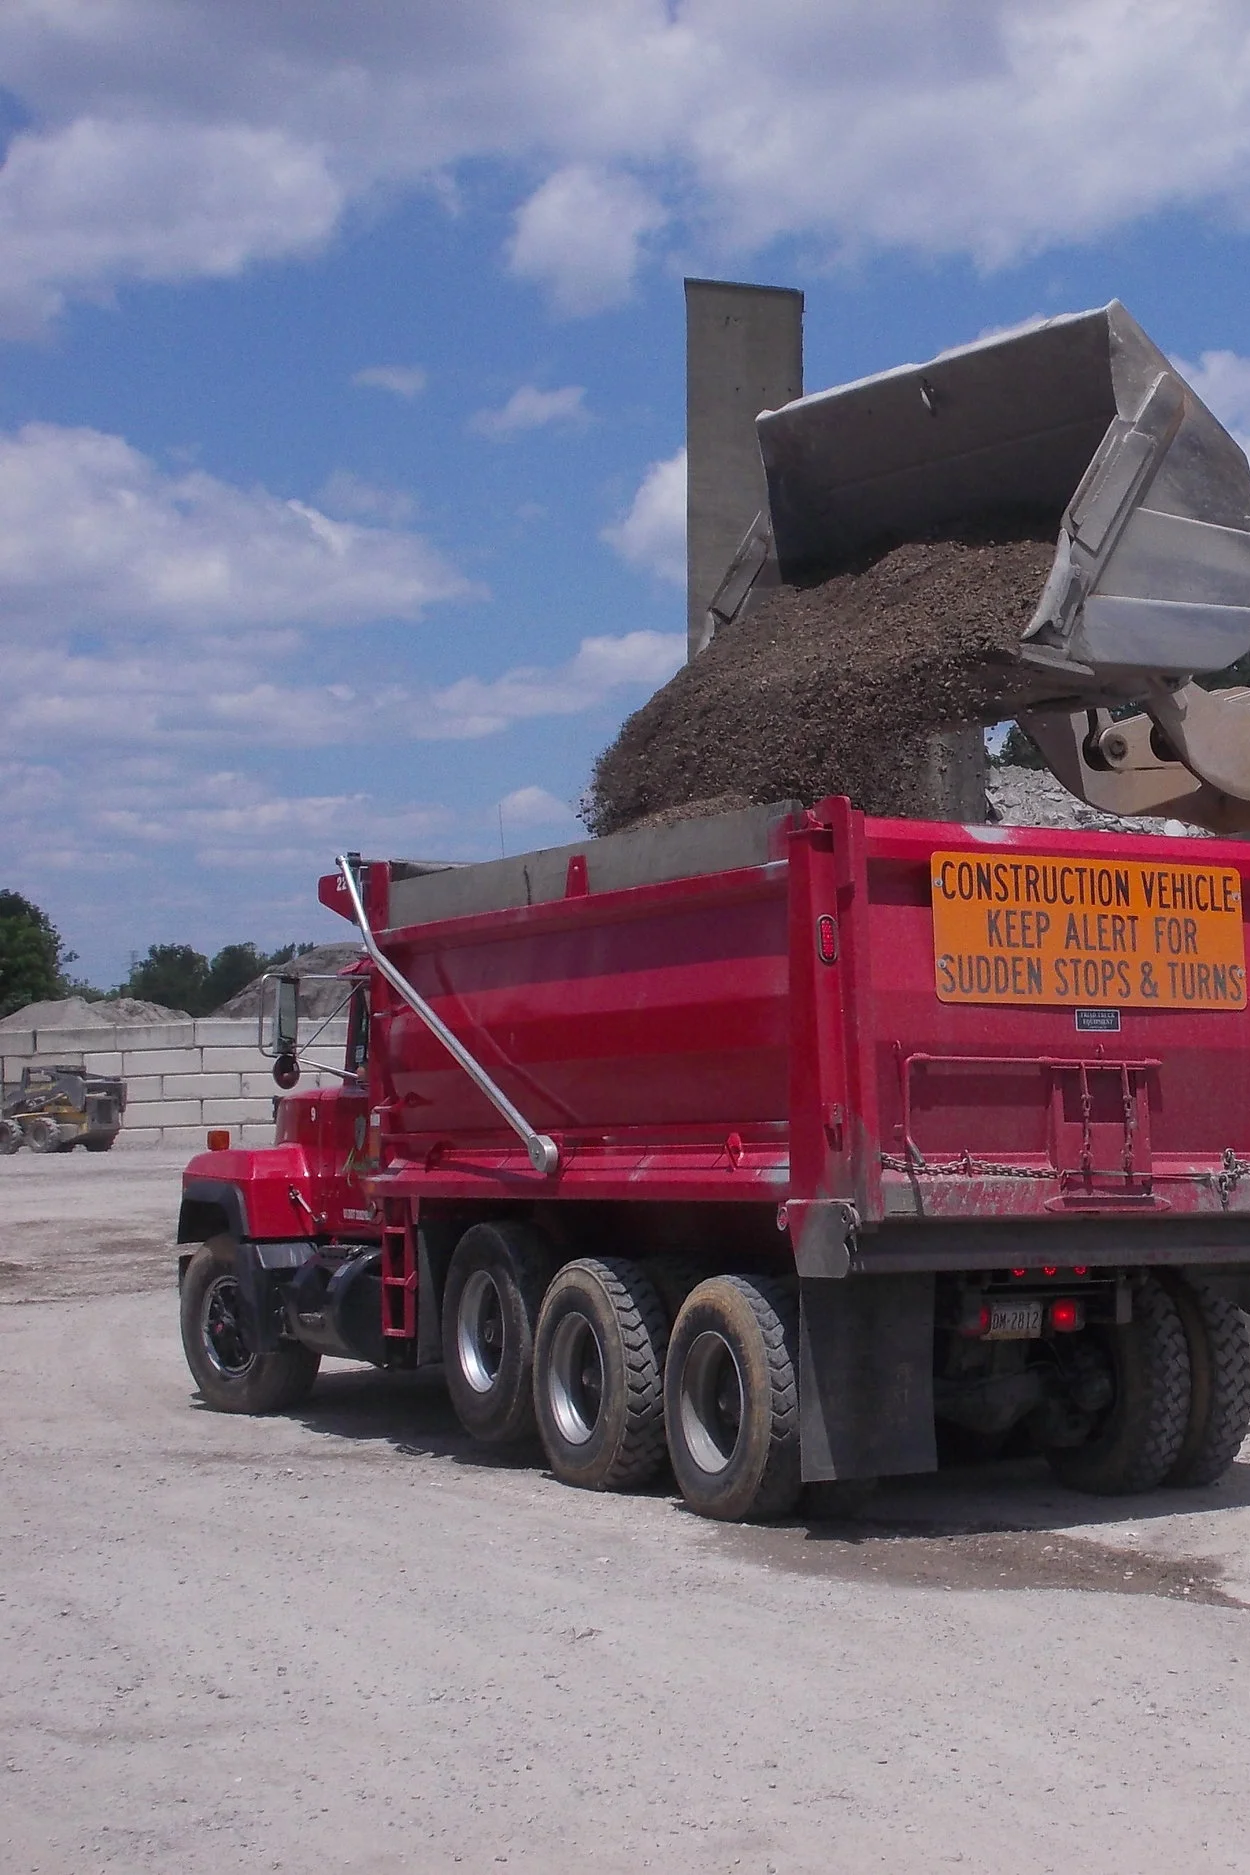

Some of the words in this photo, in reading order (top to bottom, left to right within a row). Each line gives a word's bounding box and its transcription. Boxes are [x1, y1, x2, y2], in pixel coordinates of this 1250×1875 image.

[941, 861, 1130, 906] CONSTRUCTION
[1141, 870, 1236, 913] VEHICLE
[988, 909, 1050, 949] KEEP
[1064, 913, 1139, 952] ALERT
[1154, 916, 1198, 955] FOR
[940, 953, 1042, 995] SUDDEN
[1055, 958, 1131, 998] STOPS
[1140, 961, 1159, 998] &
[1168, 962, 1243, 1001] TURNS
